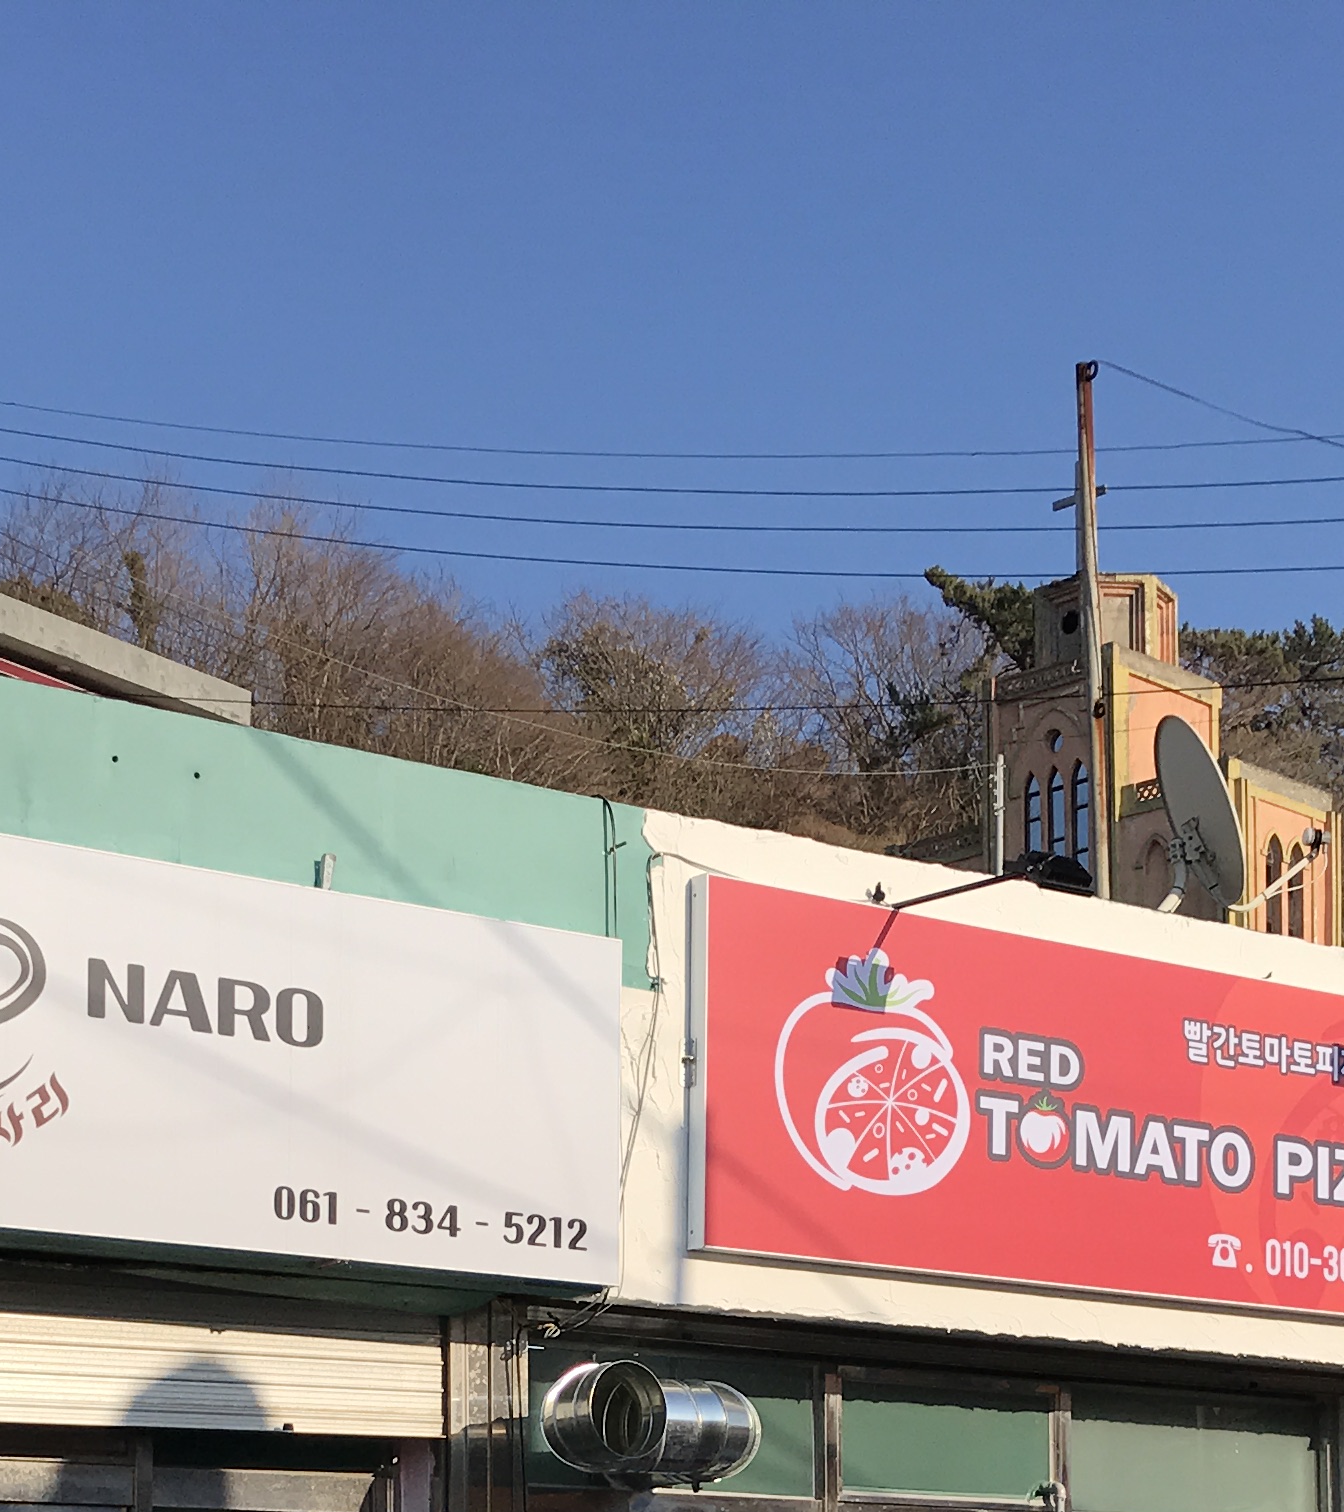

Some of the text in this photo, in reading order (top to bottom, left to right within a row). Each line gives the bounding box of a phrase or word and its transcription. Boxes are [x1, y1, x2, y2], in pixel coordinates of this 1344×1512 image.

[85, 957, 326, 1047] NARO
[981, 1029, 1080, 1088] RED
[273, 1185, 341, 1227] 061
[383, 1195, 463, 1239] 834
[501, 1207, 589, 1252] 5212
